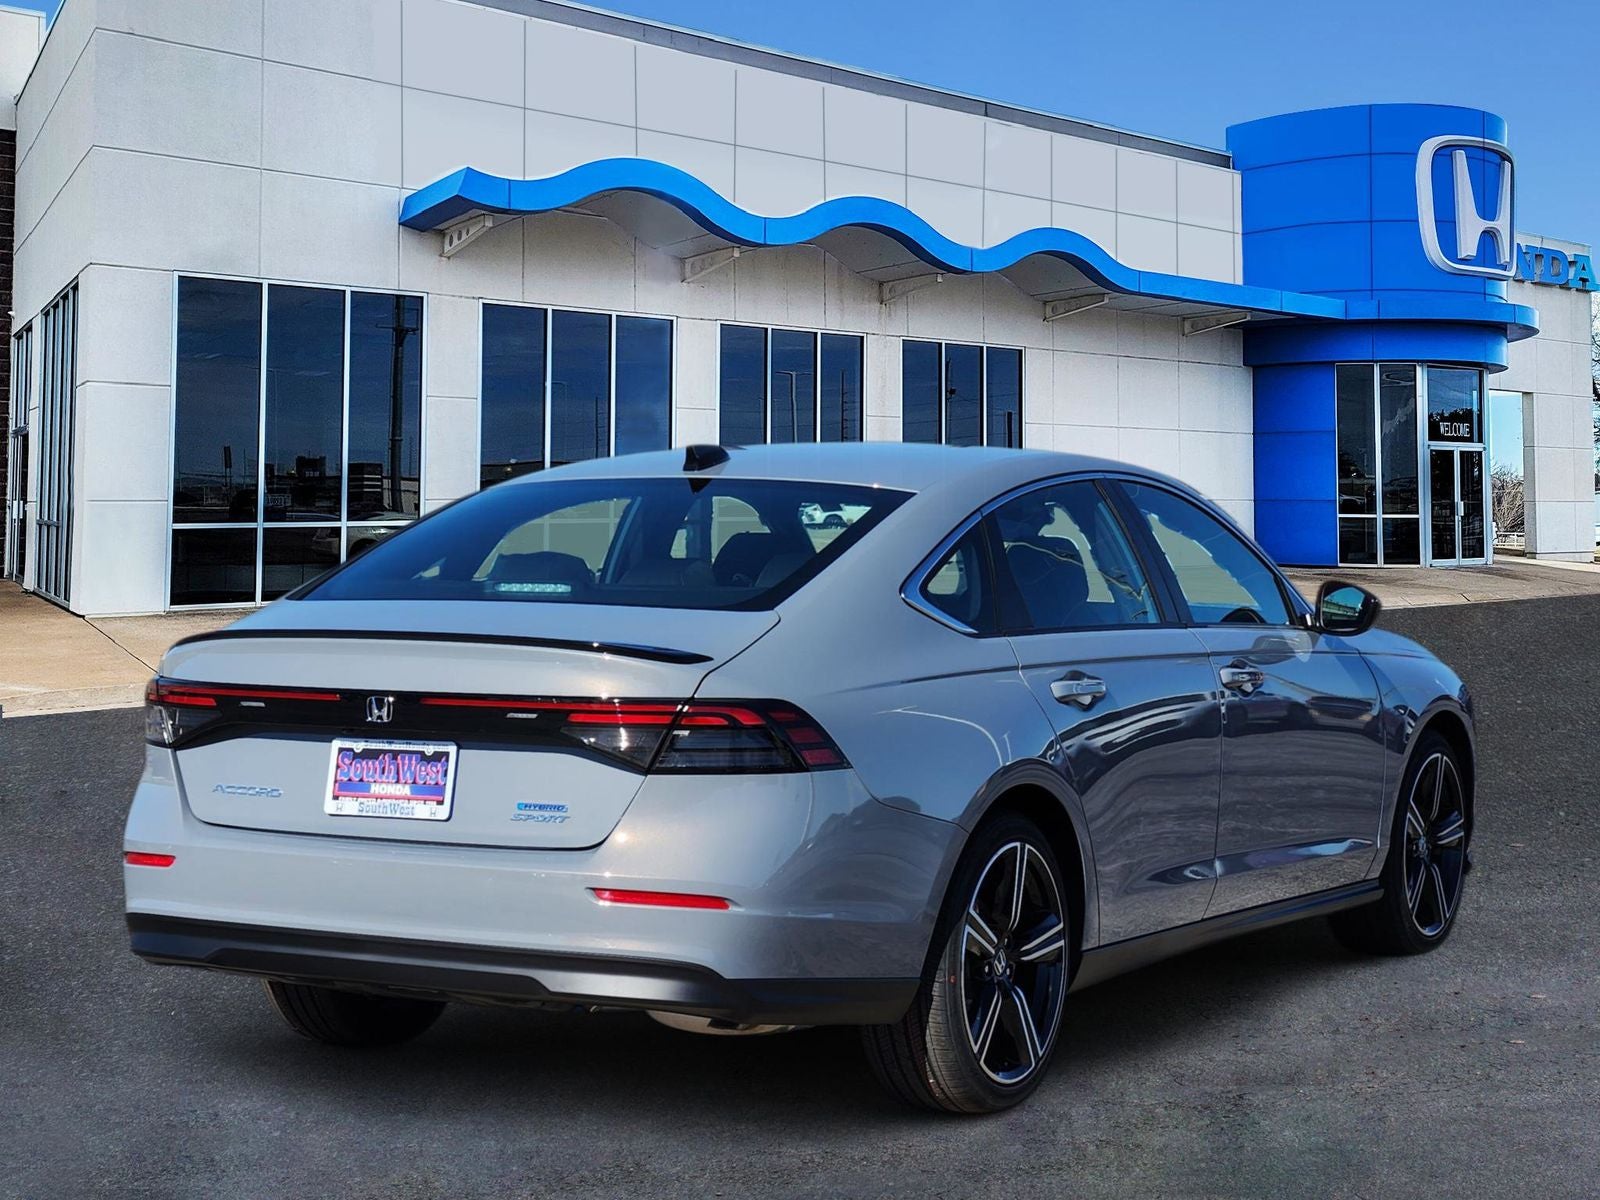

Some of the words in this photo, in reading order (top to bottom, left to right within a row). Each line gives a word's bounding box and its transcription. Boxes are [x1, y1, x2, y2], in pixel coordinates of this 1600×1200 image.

[1514, 242, 1600, 292] NDA
[1440, 422, 1470, 437] WELCOME
[337, 751, 448, 785] SouthWest
[212, 784, 282, 798] ACCORD
[370, 783, 411, 795] HONDA
[357, 802, 416, 816] SouthWest
[523, 803, 568, 813] HYBRID
[510, 813, 571, 823] SPORT
